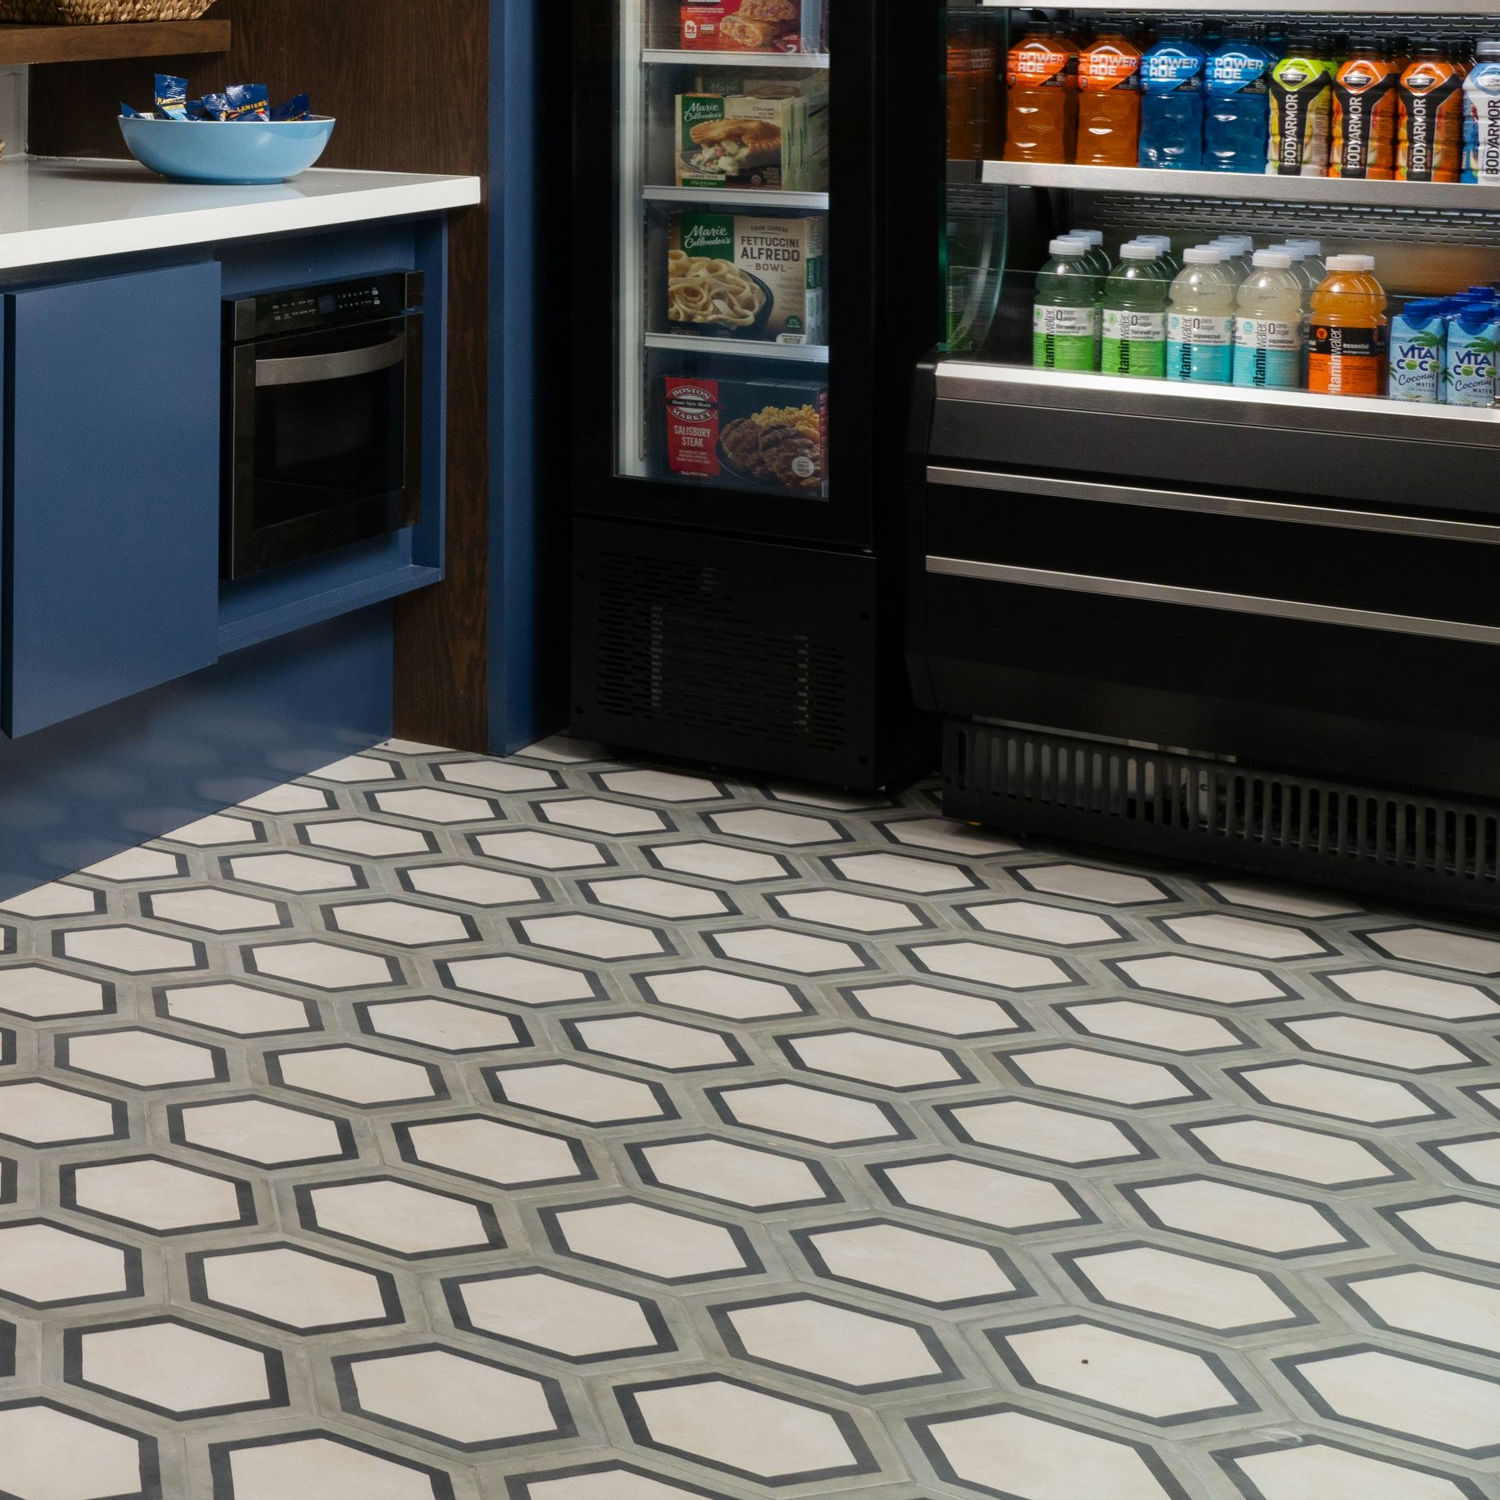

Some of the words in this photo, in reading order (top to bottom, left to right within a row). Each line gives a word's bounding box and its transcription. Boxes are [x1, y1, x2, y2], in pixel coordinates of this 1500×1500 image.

[1018, 53, 1064, 64] POWER
[1090, 54, 1137, 67] POWER
[1149, 57, 1199, 69] POWER
[1214, 57, 1264, 70] POWER
[1018, 63, 1044, 73] ADE
[1089, 64, 1117, 76] ADE
[1149, 68, 1177, 78] ADE
[1214, 68, 1242, 79] ADE
[685, 103, 719, 114] Marie
[1284, 93, 1299, 165] BODYARMOR
[1347, 96, 1362, 169] BODYARMOR
[1413, 98, 1427, 172] BODYARMOR
[1486, 99, 1500, 176] BODYARMOR
[684, 225, 728, 238] Marie
[684, 237, 732, 248] Callender's
[741, 236, 799, 248] FETTUCCINI
[741, 247, 800, 262] ALFREDO
[755, 264, 786, 272] BOWL
[1399, 344, 1435, 360] VITA
[1455, 350, 1492, 365] VITA
[1400, 373, 1435, 385] Coconut
[1455, 379, 1491, 392] Coconut
[672, 388, 710, 399] BOSTON
[673, 409, 711, 421] MARKET
[674, 426, 711, 437] SALISBURY
[682, 437, 703, 447] STEAK
